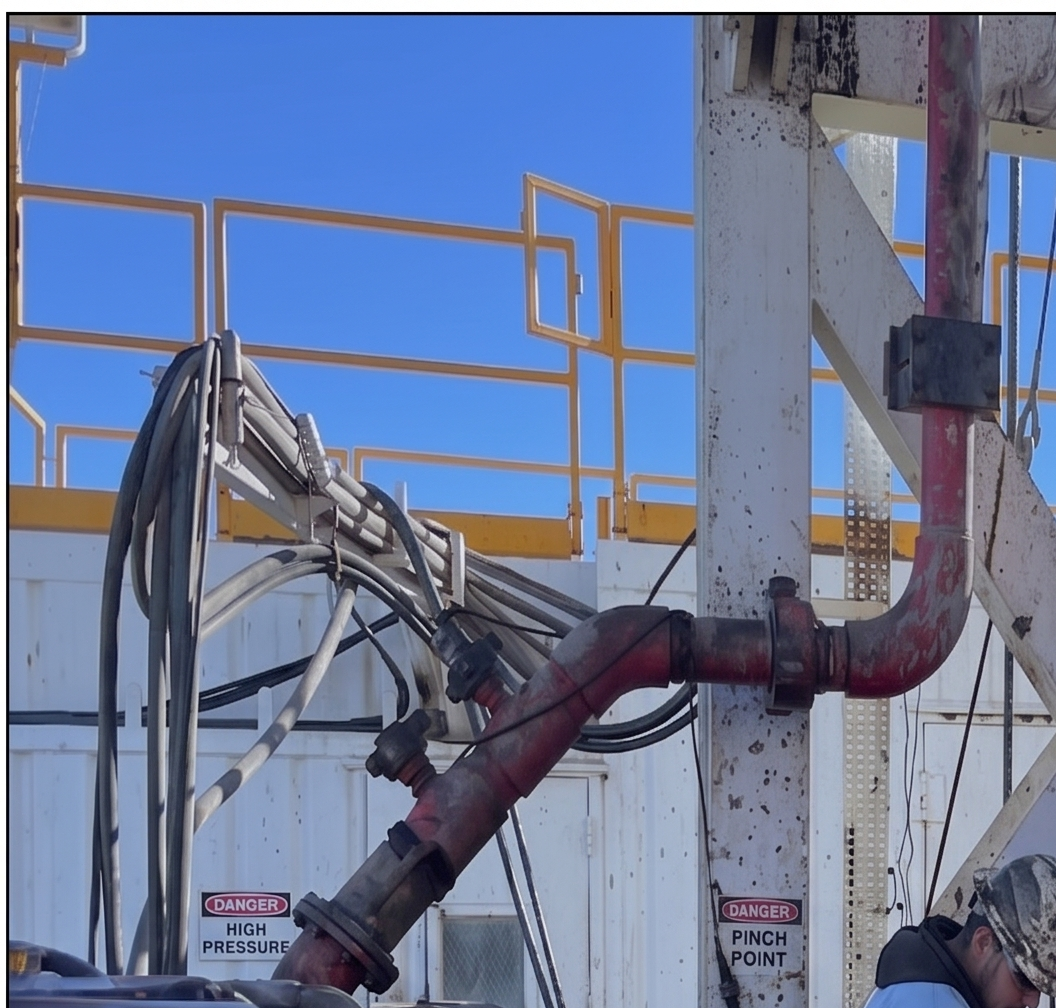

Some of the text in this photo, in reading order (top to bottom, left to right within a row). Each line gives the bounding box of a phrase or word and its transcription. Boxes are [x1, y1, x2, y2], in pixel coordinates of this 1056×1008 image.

[214, 898, 279, 912] DANGER
[729, 904, 790, 919] DANGER
[226, 923, 266, 936] HIGH
[732, 930, 787, 946] PINCH
[203, 941, 290, 954] PRESSURE
[731, 951, 787, 967] POINT
